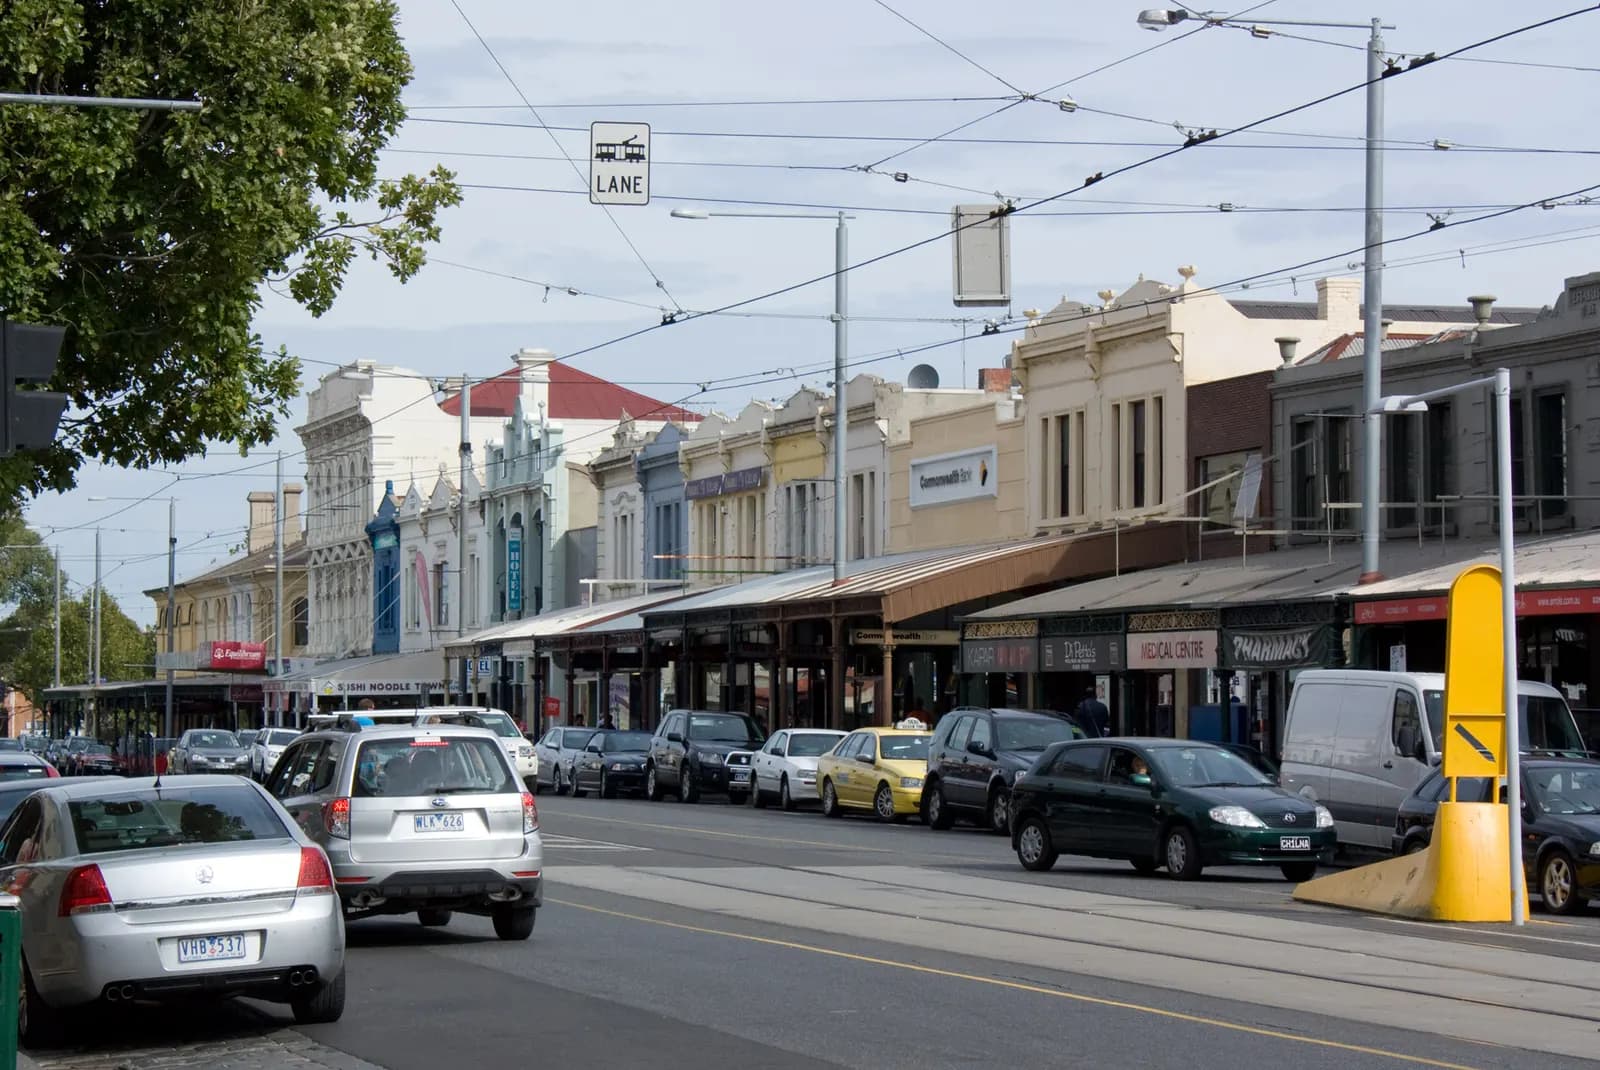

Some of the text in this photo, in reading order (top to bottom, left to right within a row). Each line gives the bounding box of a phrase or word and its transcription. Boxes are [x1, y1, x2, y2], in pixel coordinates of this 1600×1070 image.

[597, 175, 643, 193] LANE
[510, 551, 520, 599] HOTEL
[1141, 640, 1204, 659] MEDICAL CENTRE
[1232, 632, 1312, 662] PHARMACY
[369, 682, 411, 691] NOODLE
[414, 681, 446, 692] TWN
[415, 815, 462, 829] WLK 626
[182, 936, 242, 956] VHB 537
